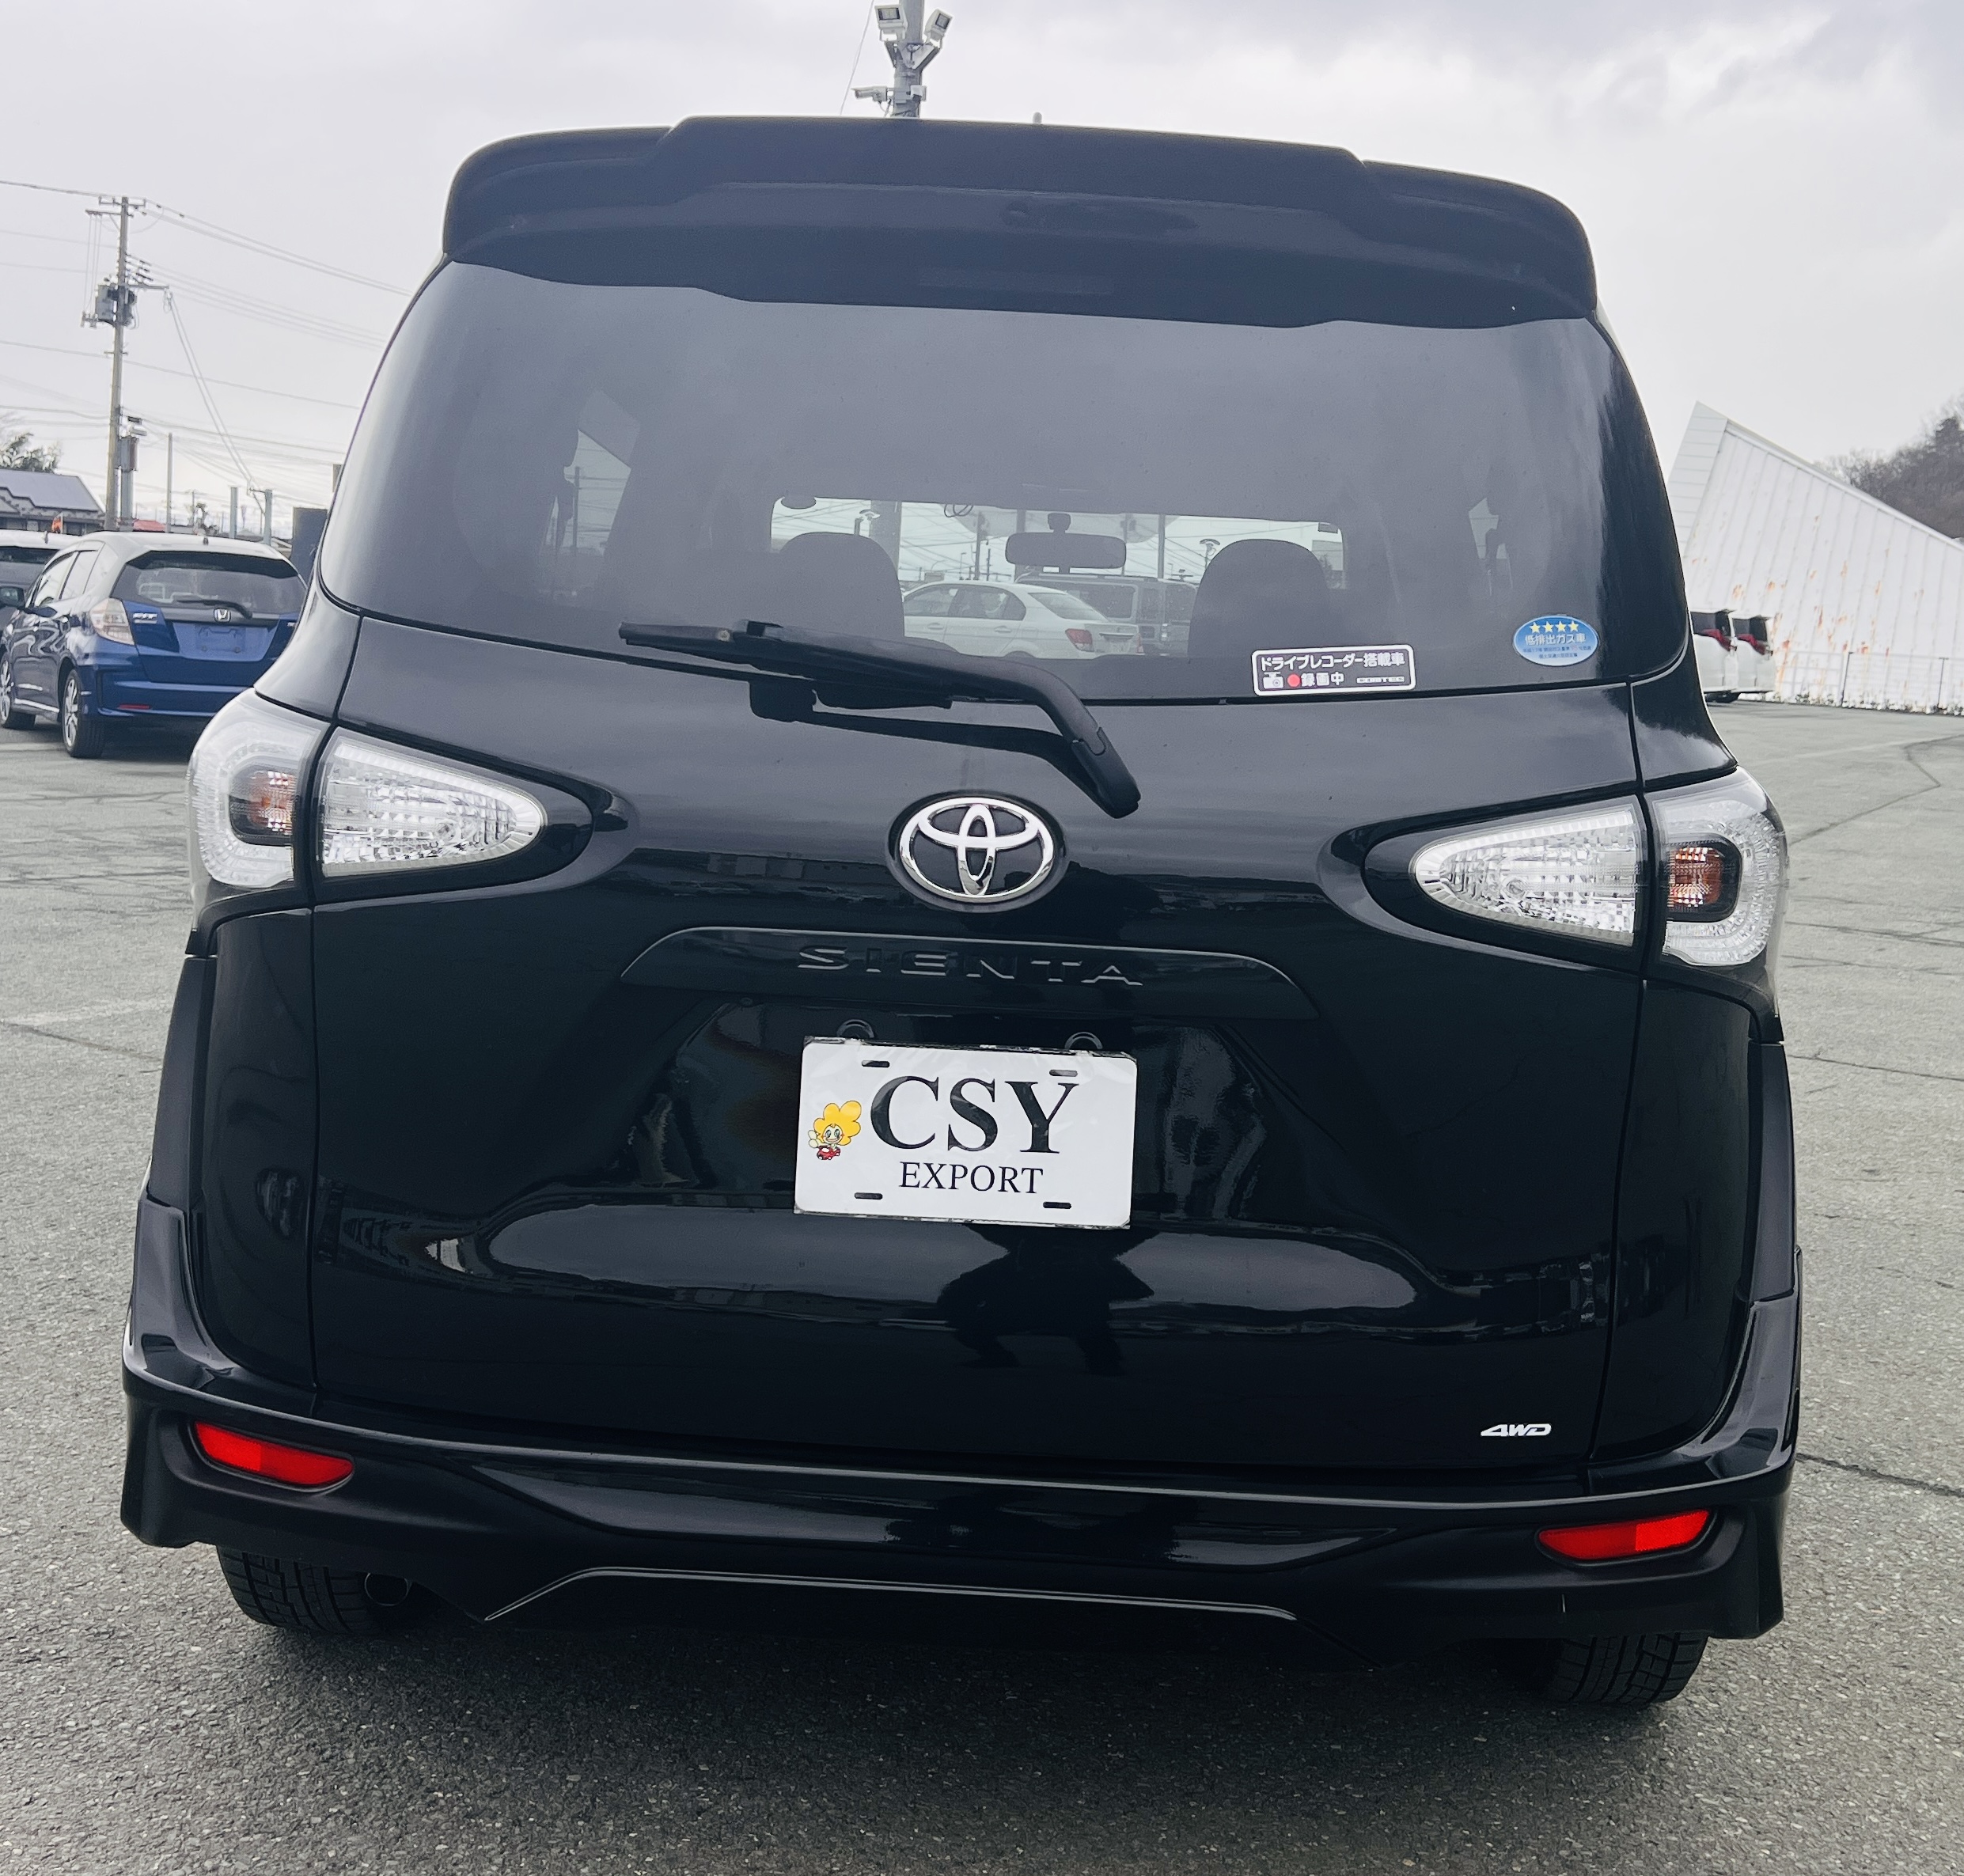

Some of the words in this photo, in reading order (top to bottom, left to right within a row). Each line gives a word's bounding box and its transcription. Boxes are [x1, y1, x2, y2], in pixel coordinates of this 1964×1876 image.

[1525, 633, 1587, 646] 低排出ガス車
[1261, 652, 1405, 671] ドライブレコーダー搭載車
[797, 946, 1143, 986] SIENTA
[870, 1075, 1079, 1154] CSY
[898, 1161, 1043, 1194] EXPORT
[1481, 1423, 1552, 1437] 4WD
